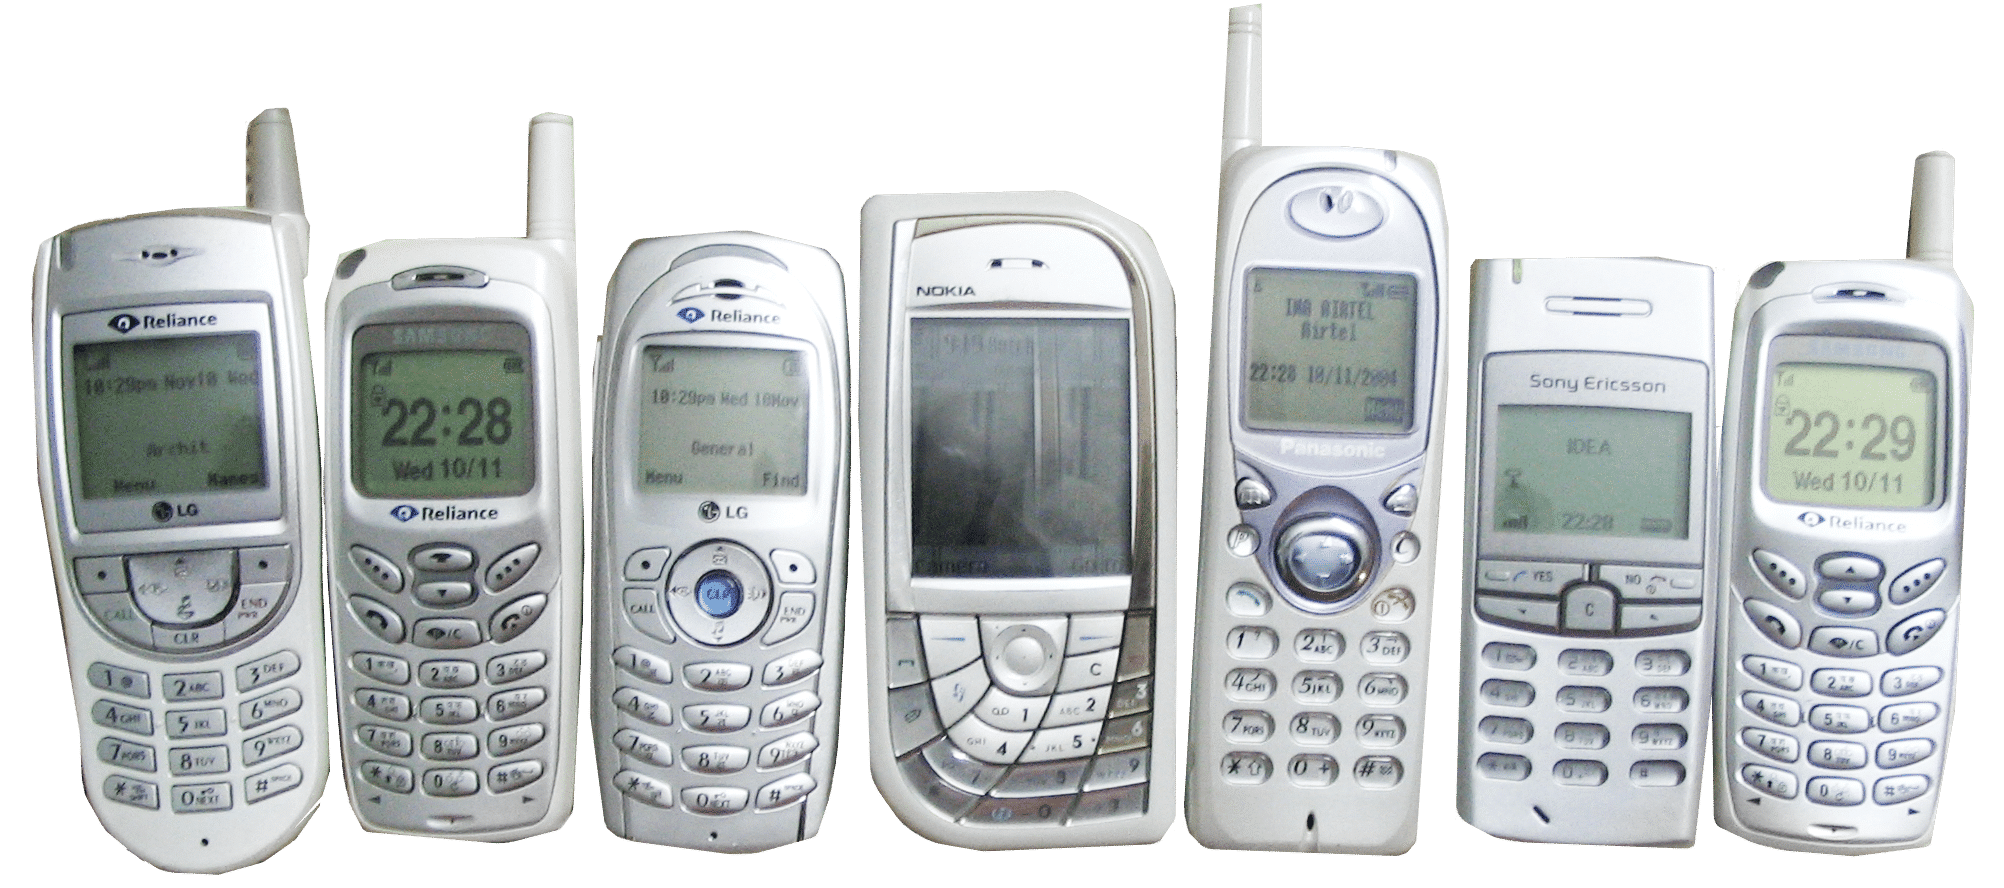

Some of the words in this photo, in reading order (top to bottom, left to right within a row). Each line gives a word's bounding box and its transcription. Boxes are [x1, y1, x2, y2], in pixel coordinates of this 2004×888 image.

[917, 286, 976, 296] NOKIA
[711, 310, 780, 324] Reliance
[1321, 300, 1374, 320] AIRTEL
[144, 313, 217, 329] Reliance
[1301, 322, 1357, 340] Airtel
[1250, 363, 1296, 382] 22:28
[1530, 374, 1578, 392] Sony
[1585, 377, 1666, 393] Ericsson
[652, 390, 716, 406] 10:29pm
[721, 392, 748, 406] Wed
[382, 397, 512, 447] 22:28
[1784, 409, 1916, 462] 22:29
[692, 441, 753, 456] General
[1281, 439, 1385, 458] Panasonic
[1566, 438, 1611, 455] IDEA
[393, 459, 433, 480] Wed
[441, 457, 502, 478] 10/11
[646, 471, 683, 484] Menu
[763, 473, 799, 487] Find
[1793, 471, 1834, 492] Wed
[1842, 471, 1903, 493] 10/11
[178, 504, 198, 517] LG
[423, 506, 498, 520] Reliance
[726, 506, 748, 519] LG
[1830, 516, 1907, 533] Reliance
[1534, 571, 1552, 582] YES
[1625, 575, 1641, 585] NO
[241, 598, 267, 608] END
[631, 605, 655, 613] CALL
[1586, 603, 1594, 616] C
[103, 609, 133, 621] CALL
[784, 607, 805, 615] END
[174, 633, 199, 643] CLR
[1236, 632, 1244, 649] 1
[1301, 635, 1314, 651] 2
[1314, 645, 1333, 654] ABC
[1367, 637, 1380, 653] 3
[1382, 646, 1401, 655] DEF
[366, 658, 372, 670] 1
[631, 654, 636, 666] 1
[1568, 656, 1578, 669] 2
[1643, 657, 1653, 671] 3
[251, 667, 259, 683] 3
[264, 663, 285, 673] DEF
[431, 668, 438, 681] 2
[497, 664, 505, 677] 3
[701, 669, 711, 682] 2
[776, 667, 783, 680] 3
[1090, 663, 1101, 676] C
[1761, 663, 1766, 676] 1
[105, 670, 112, 686] 1
[1232, 673, 1244, 690] 4
[1245, 682, 1265, 692] GHI
[1827, 677, 1836, 689] 2
[1893, 677, 1902, 689] 3
[175, 680, 186, 696] 2
[190, 683, 209, 692] ABC
[1137, 684, 1147, 699] 3
[1299, 677, 1311, 693] 5
[1311, 684, 1331, 694] JKL
[1364, 679, 1375, 695] 6
[1491, 688, 1500, 698] 4
[1566, 694, 1575, 706] 5
[368, 694, 375, 707] 4
[497, 700, 505, 713] 6
[628, 696, 639, 710] 4
[1060, 707, 1080, 715] ABC
[1086, 698, 1096, 712] 2
[1641, 694, 1650, 707] 6
[1756, 699, 1765, 713] 4
[106, 707, 117, 722] 4
[120, 714, 140, 723] GHI
[252, 703, 262, 719] 6
[264, 699, 288, 707] MNO
[436, 704, 444, 716] 5
[773, 707, 783, 721] 6
[1022, 709, 1028, 722] 1
[701, 710, 709, 725] 5
[1231, 716, 1243, 733] 7
[1824, 714, 1833, 726] 5
[1891, 712, 1899, 724] 6
[179, 717, 188, 733] 5
[1131, 721, 1142, 736] 6
[1296, 717, 1309, 733] 8
[1311, 727, 1330, 736] TUV
[1362, 720, 1374, 735] 9
[368, 729, 375, 741] 7
[499, 735, 507, 747] 9
[1565, 730, 1574, 742] 8
[1639, 732, 1649, 744] 9
[1758, 734, 1766, 747] 7
[255, 741, 265, 756] 9
[434, 740, 442, 753] 8
[629, 736, 639, 750] 7
[967, 737, 986, 746] GHI
[997, 741, 1007, 755] 4
[1045, 742, 1063, 752] JKL
[1073, 735, 1082, 749] 5
[110, 744, 120, 760] 7
[770, 748, 779, 762] 9
[1824, 748, 1832, 761] 8
[1888, 749, 1897, 760] 9
[181, 754, 191, 769] 8
[196, 758, 215, 766] TUV
[699, 753, 709, 767] 8
[1130, 758, 1140, 772] 9
[1294, 760, 1307, 775] 0
[1360, 761, 1375, 777] #
[256, 779, 268, 792] #
[770, 789, 780, 802] #
